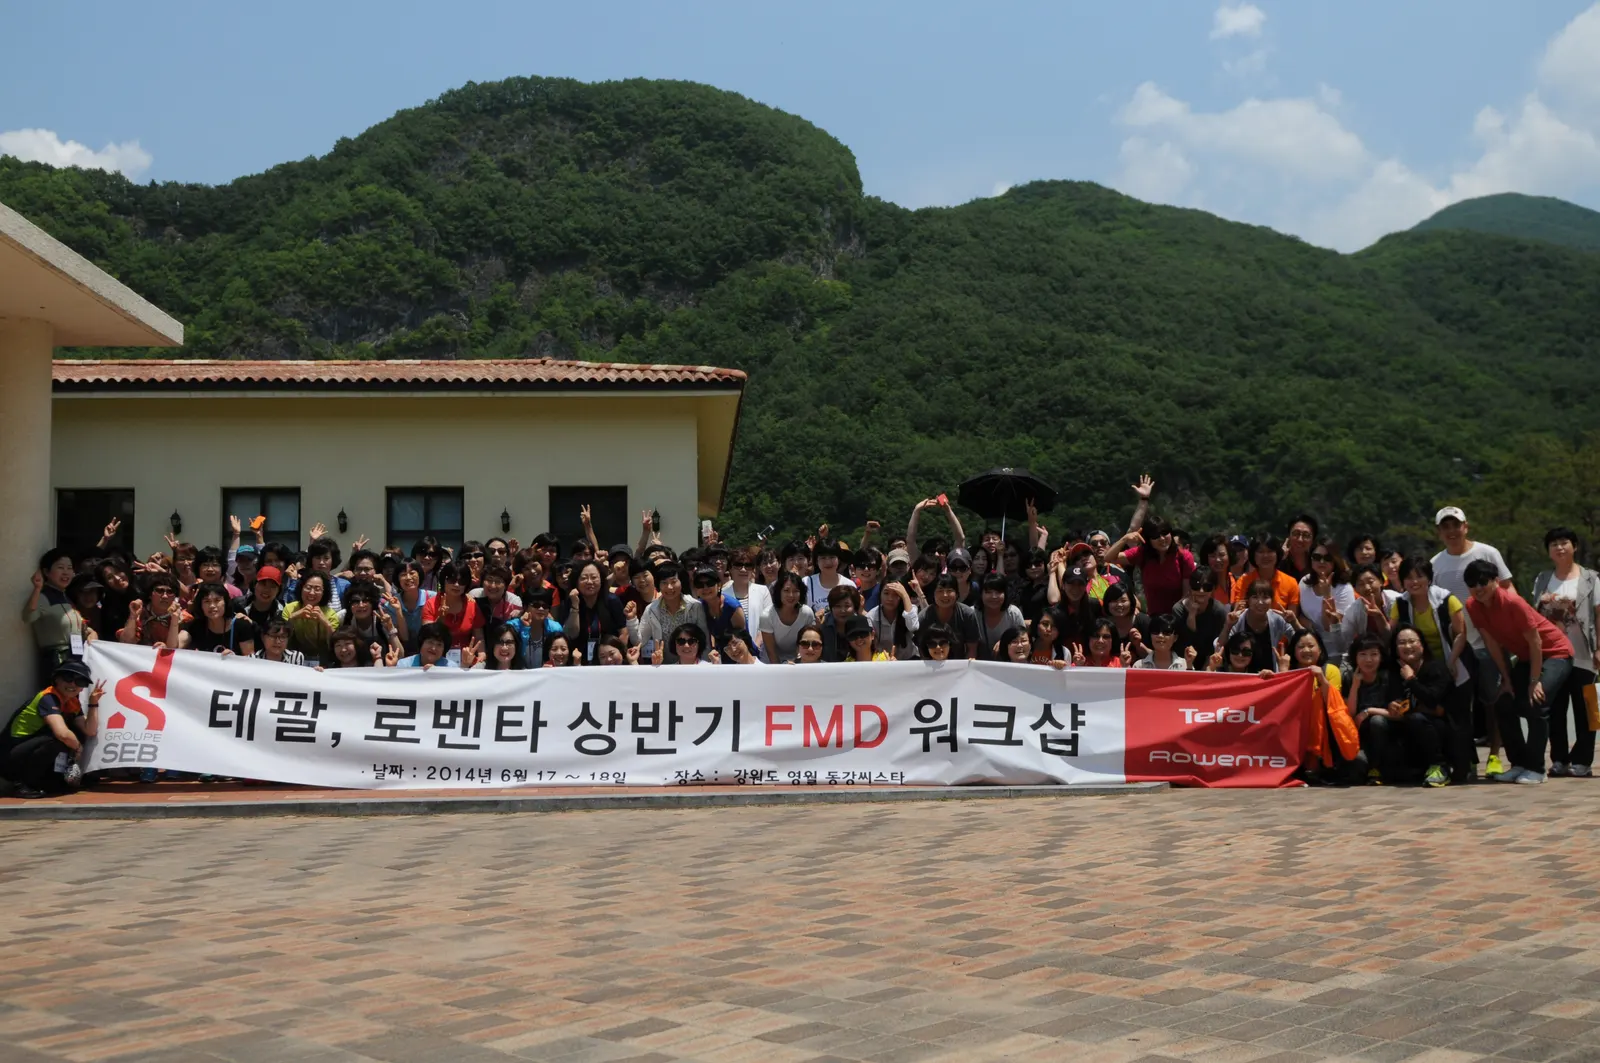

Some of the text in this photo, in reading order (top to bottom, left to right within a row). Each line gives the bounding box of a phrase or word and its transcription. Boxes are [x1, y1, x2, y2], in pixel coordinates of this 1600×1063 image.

[208, 688, 1087, 757] 테팔, 로벤타 상반기 FMD 워크샵
[1178, 705, 1261, 725] Tefal
[104, 731, 162, 743] GROUPE
[101, 742, 159, 764] SEB
[373, 764, 405, 780] 날짜
[426, 766, 492, 784] 2014년
[500, 768, 528, 783] 6월
[536, 770, 557, 781] 17
[589, 772, 626, 784] 18일
[674, 769, 706, 785] 장소
[733, 769, 780, 786] 강원도
[787, 770, 818, 786] 영월
[824, 770, 906, 786] 동강씨스타
